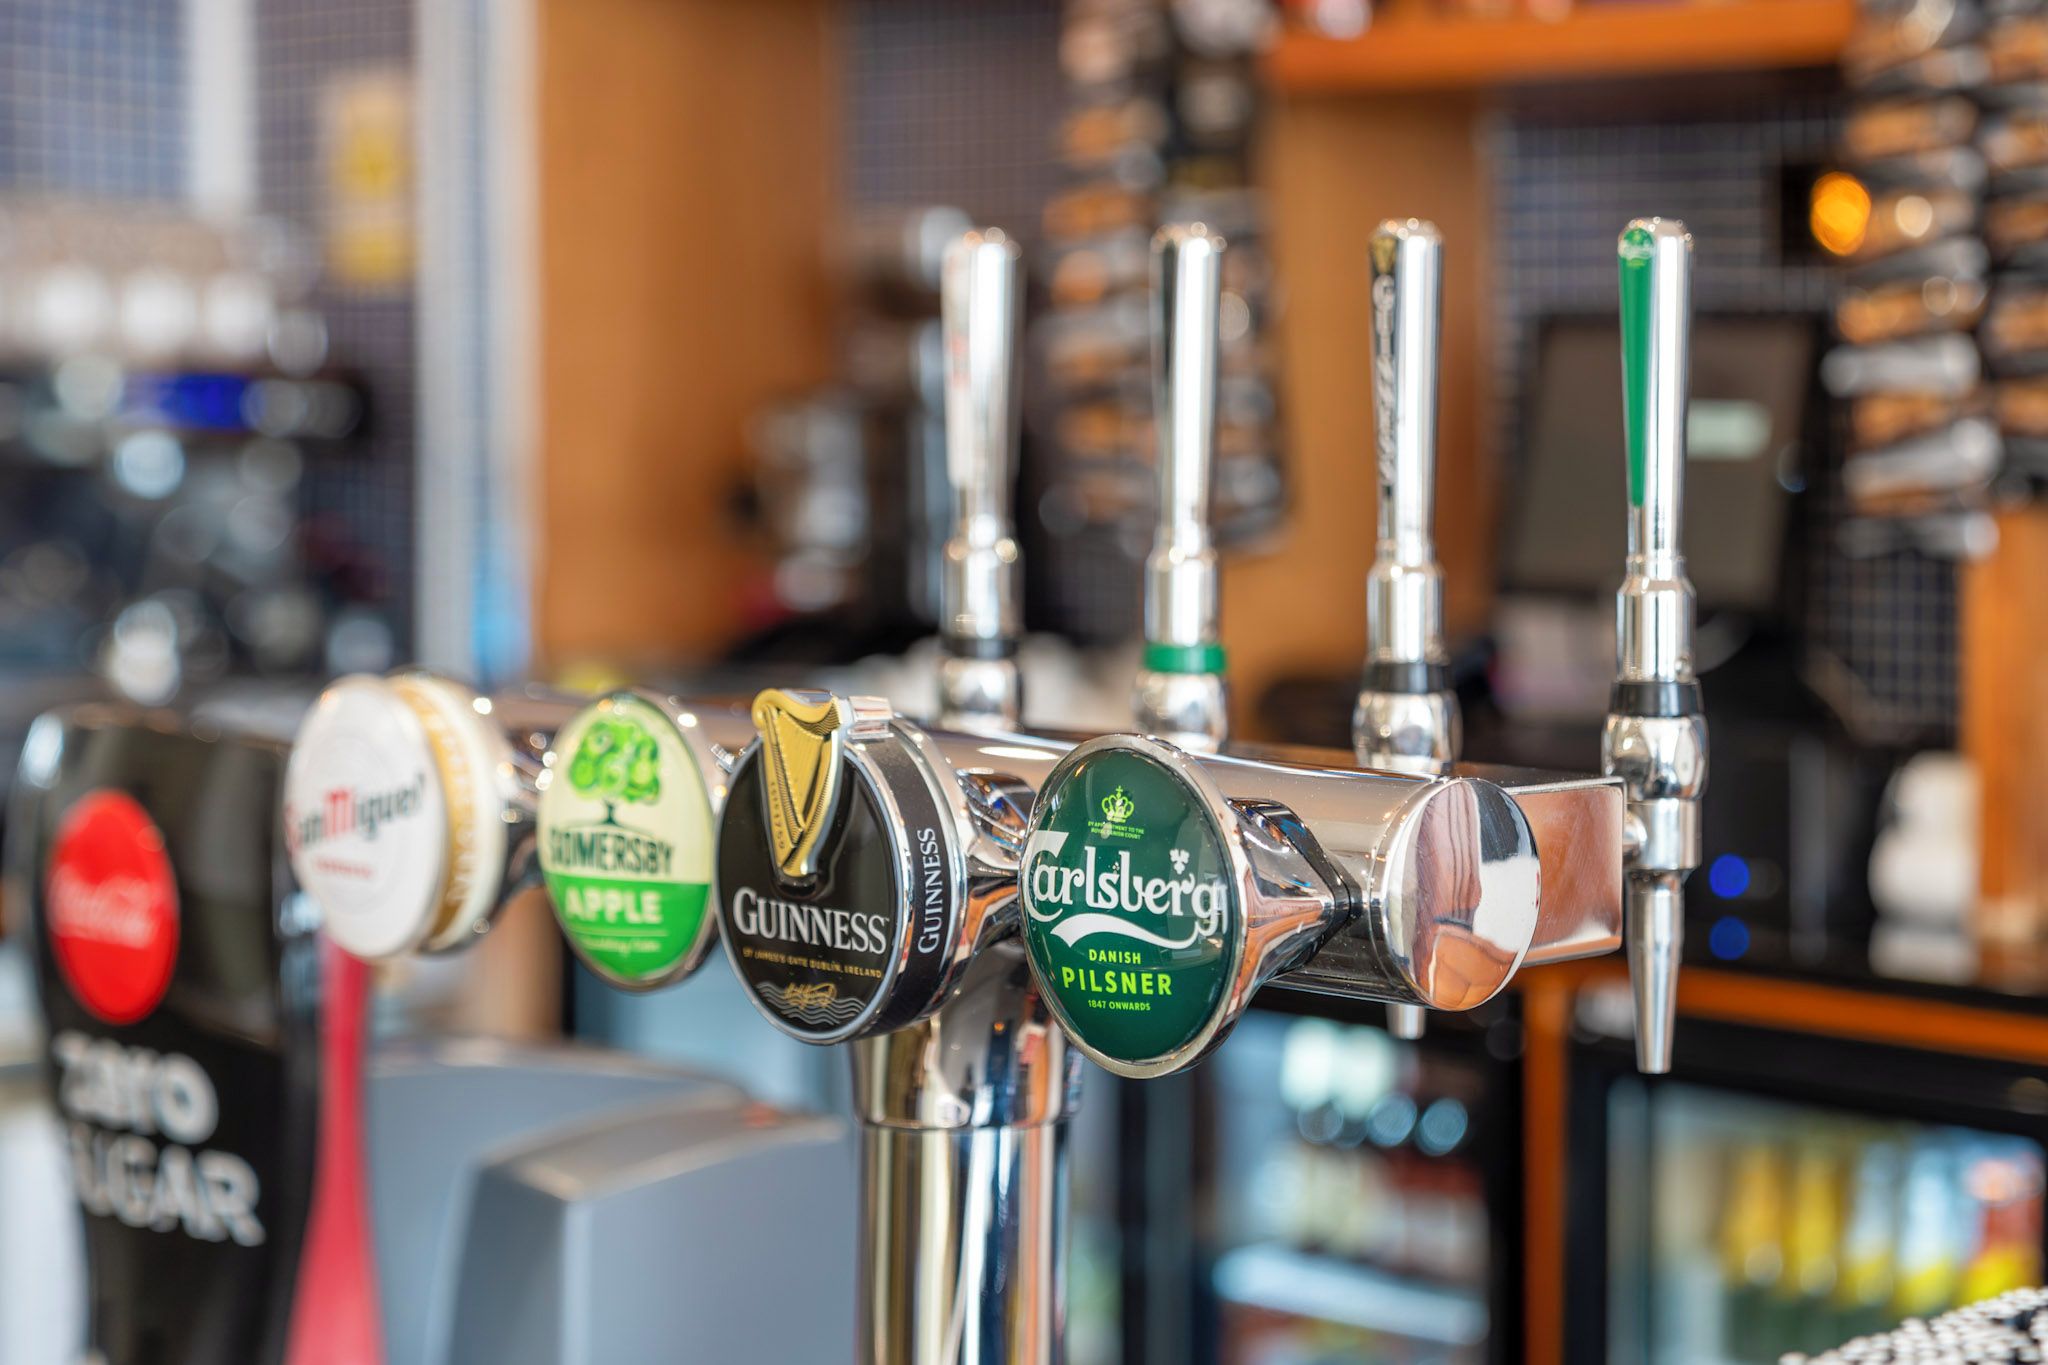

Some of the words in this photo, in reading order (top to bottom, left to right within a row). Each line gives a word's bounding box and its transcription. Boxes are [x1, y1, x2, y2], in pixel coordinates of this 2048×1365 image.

[551, 826, 676, 876] SOMERSBY
[917, 827, 945, 954] GUINNESS
[1021, 829, 1228, 938] Carlsberg
[564, 886, 664, 924] APPLE
[732, 886, 888, 955] GUINNESS
[844, 964, 882, 979] IRELAND
[1088, 948, 1141, 965] DANISH
[1061, 966, 1173, 996] PILSNER
[1087, 999, 1107, 1009] 1847
[1108, 1001, 1152, 1011] ONWARDS
